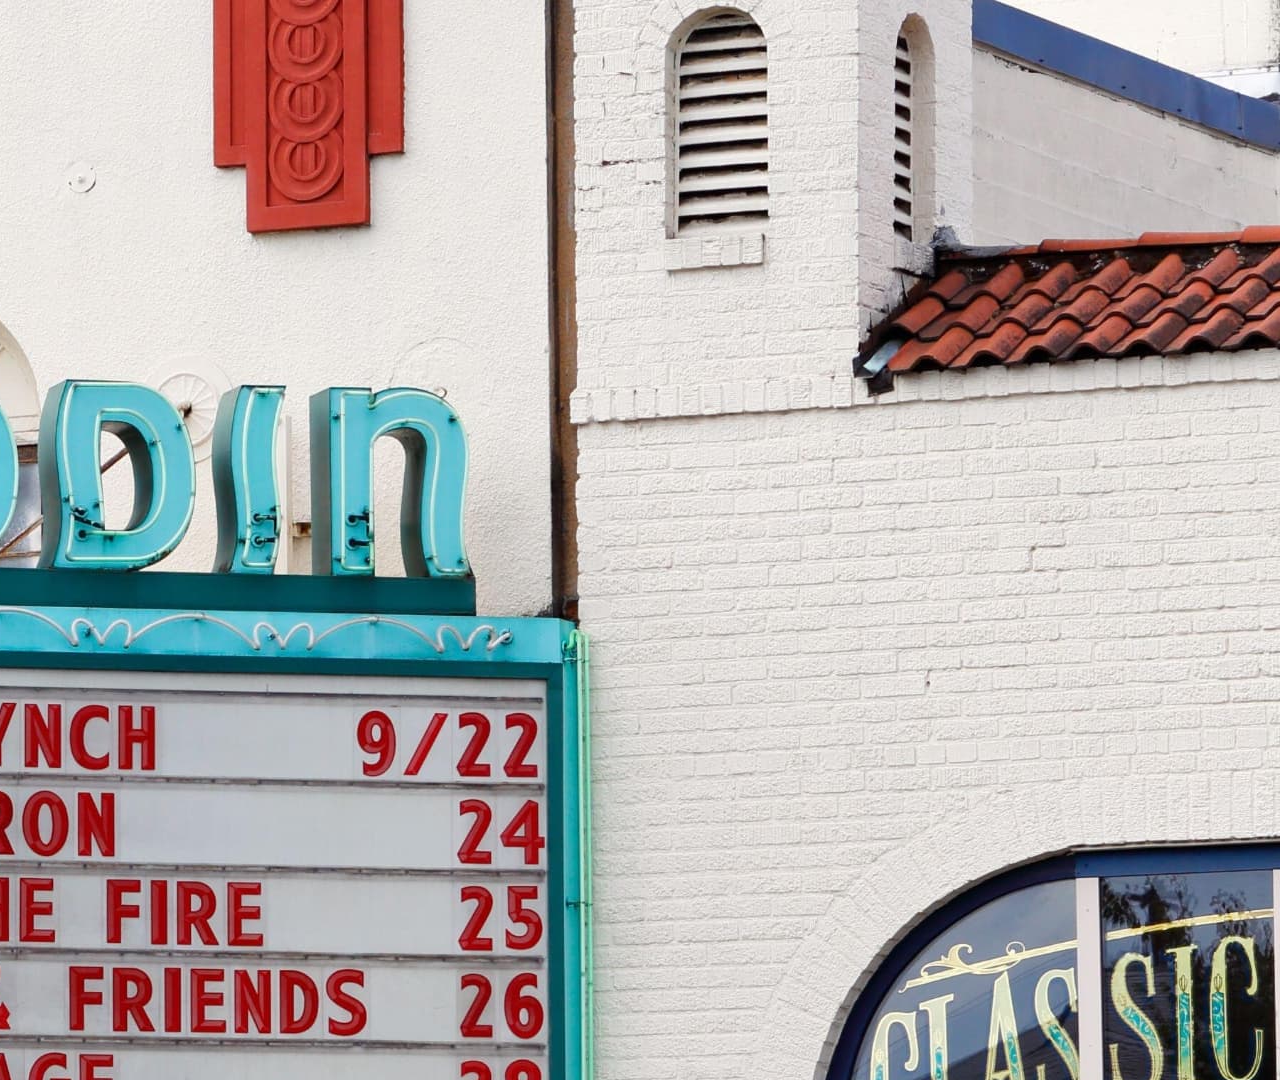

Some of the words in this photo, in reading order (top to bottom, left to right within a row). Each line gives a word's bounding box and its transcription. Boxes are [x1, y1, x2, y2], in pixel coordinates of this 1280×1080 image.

[356, 710, 539, 778] 9/22
[458, 799, 546, 866] 24
[106, 879, 265, 947] FIRE
[458, 885, 544, 952] 25
[68, 965, 368, 1037] FRIENDS
[460, 972, 545, 1040] 26
